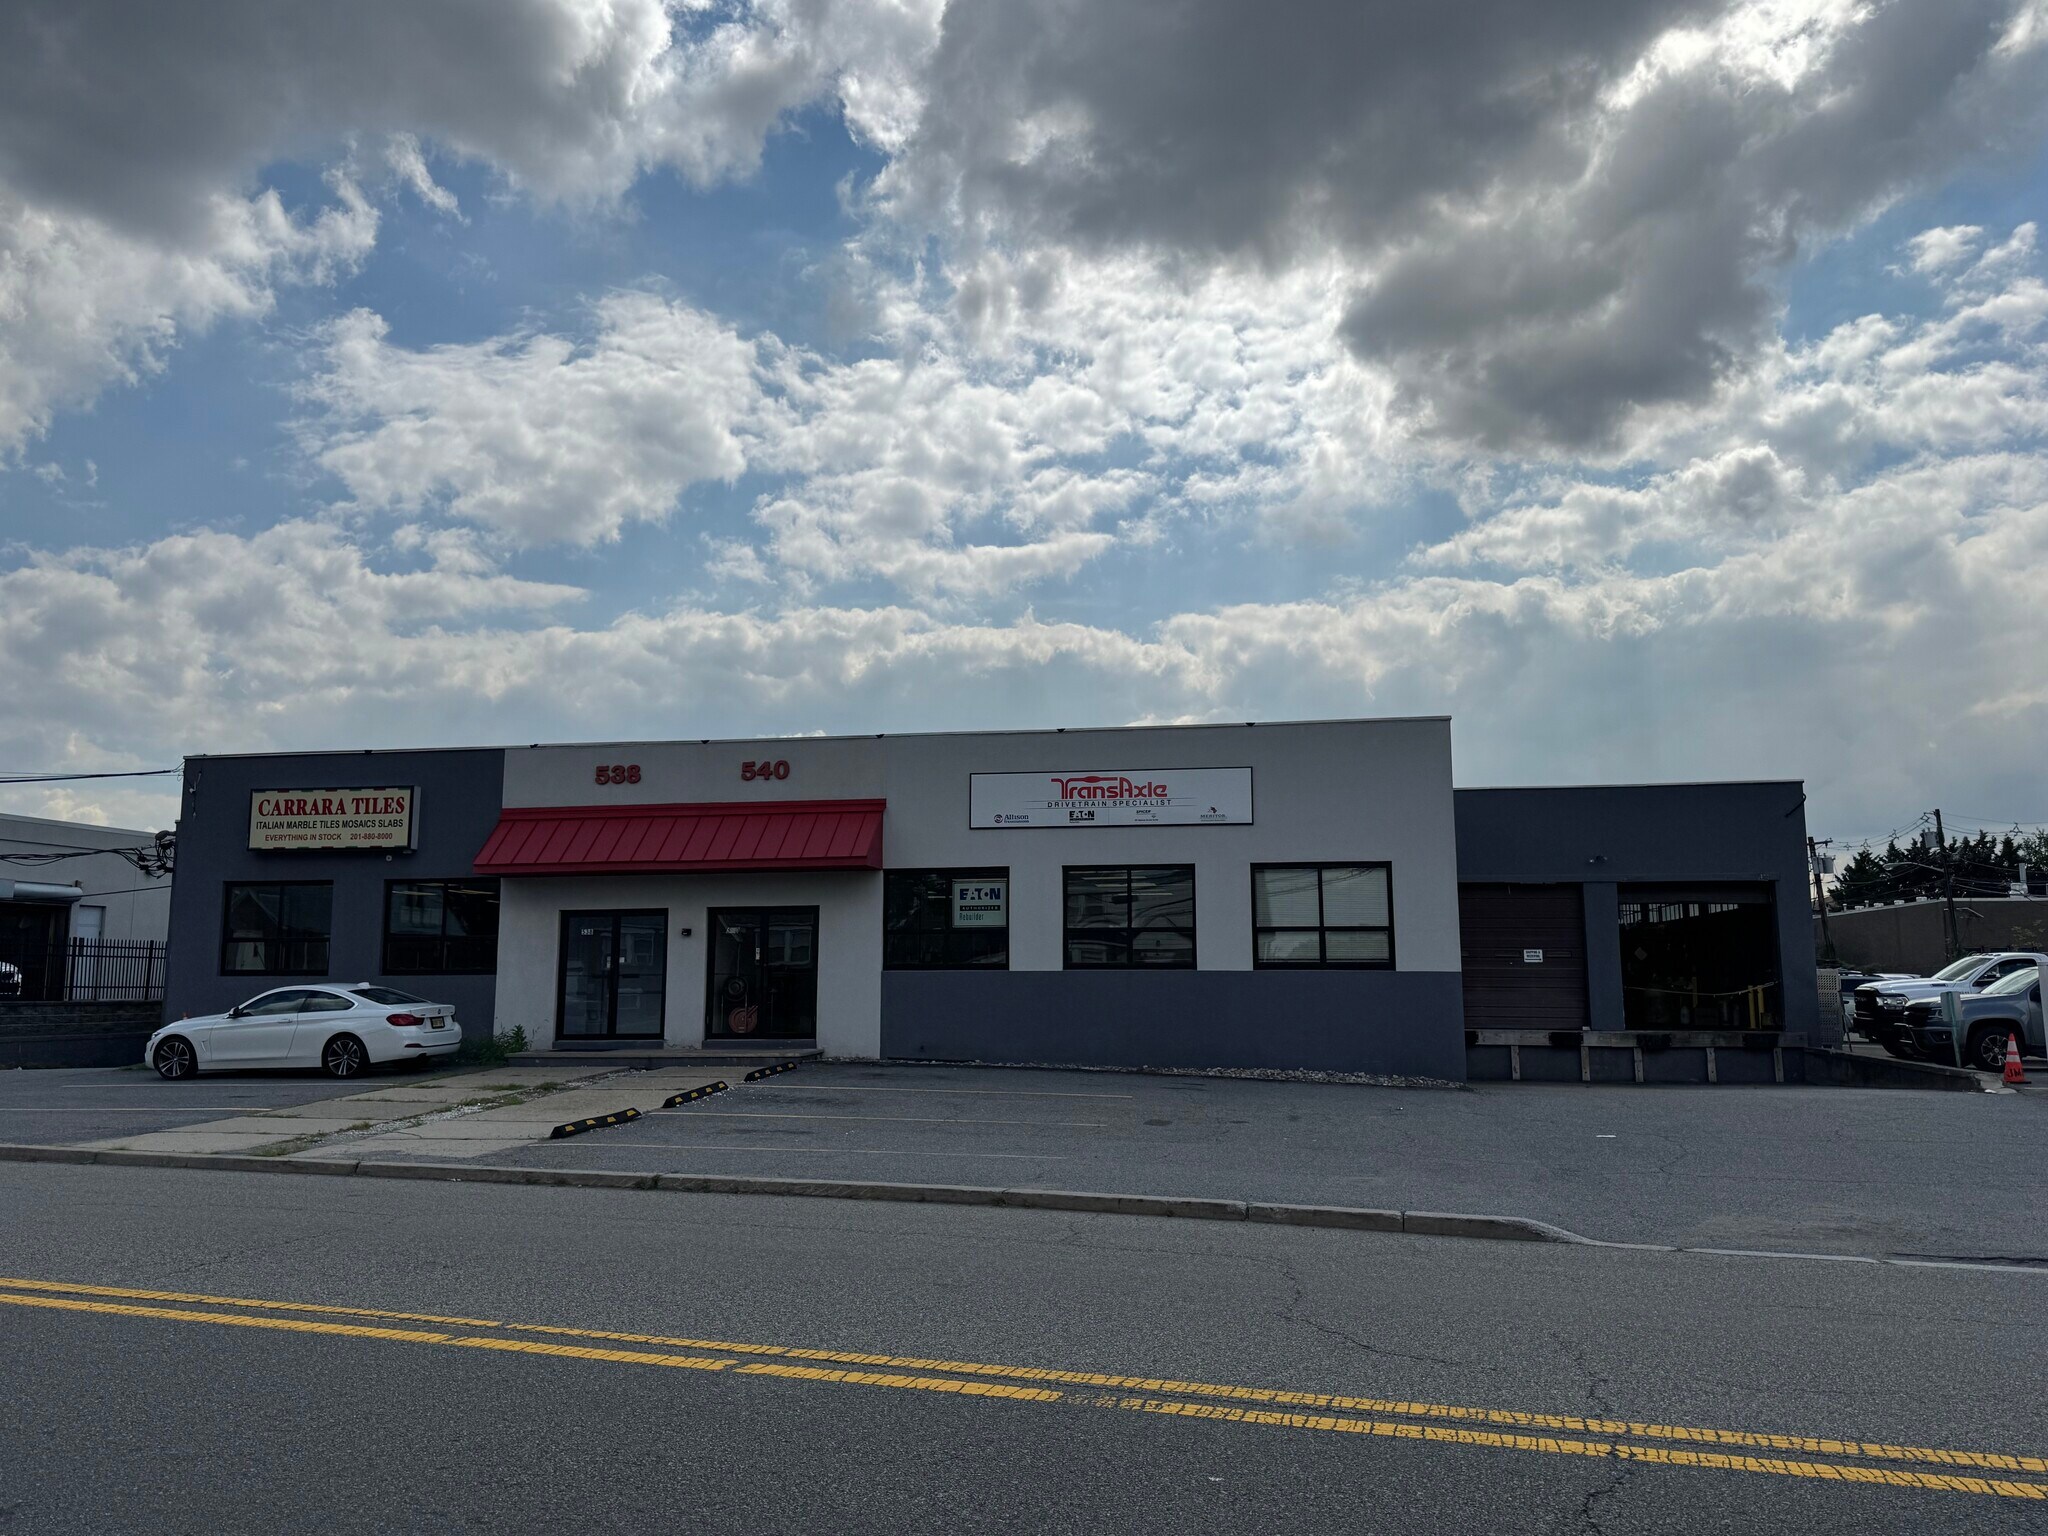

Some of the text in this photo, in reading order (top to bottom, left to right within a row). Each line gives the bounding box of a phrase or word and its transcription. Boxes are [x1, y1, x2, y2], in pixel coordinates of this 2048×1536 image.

[595, 764, 642, 785] 538
[741, 760, 790, 781] 540
[1050, 775, 1168, 800] TransAxle
[258, 796, 405, 816] CARRARA TILES
[1069, 810, 1095, 818] EATON
[256, 818, 404, 830] ITALIAN MARBLE TILES MOSAICS SLABS
[265, 833, 308, 841] EVERYTHING
[309, 833, 317, 841] IN
[318, 833, 342, 841] STOCK
[960, 888, 1000, 900] EATON
